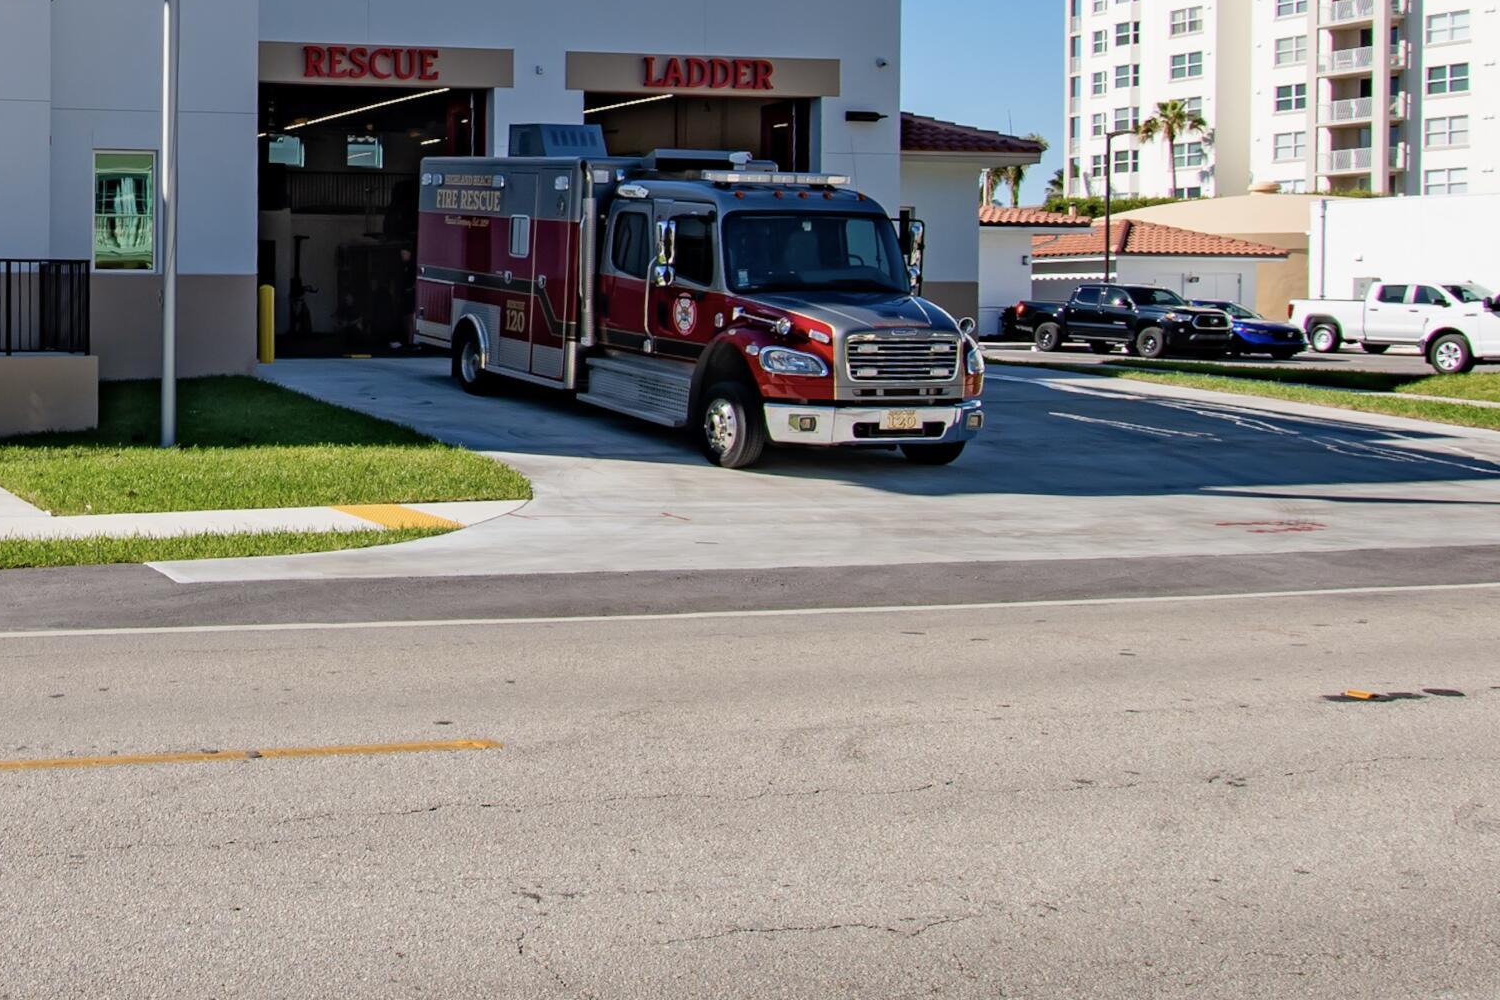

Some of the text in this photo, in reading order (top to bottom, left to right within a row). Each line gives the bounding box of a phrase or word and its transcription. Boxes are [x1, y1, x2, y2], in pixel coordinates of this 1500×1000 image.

[303, 45, 439, 80] RESCUE
[643, 55, 774, 90] LADDER
[436, 188, 501, 212] FIRE RESCUE
[505, 309, 525, 333] 120
[886, 414, 917, 429] 120
